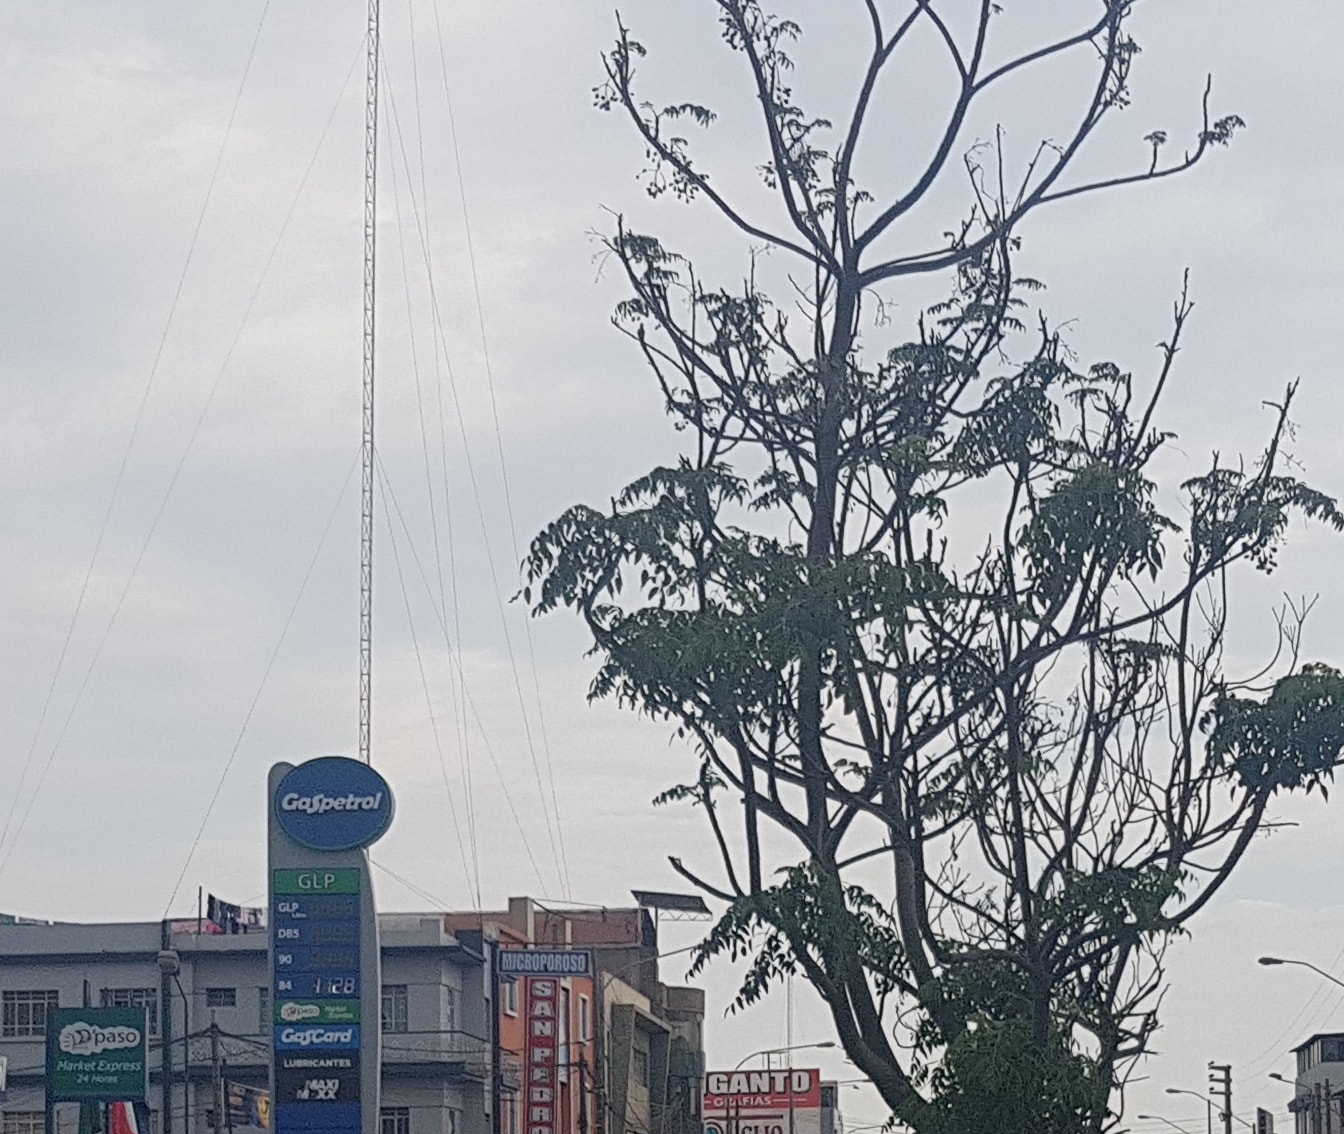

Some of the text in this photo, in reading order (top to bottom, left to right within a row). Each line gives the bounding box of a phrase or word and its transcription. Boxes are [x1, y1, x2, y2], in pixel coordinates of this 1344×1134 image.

[297, 873, 336, 889] GLP
[278, 902, 300, 913] GLP
[278, 928, 300, 939] DB5
[278, 954, 293, 965] 90
[501, 952, 587, 972] MICROPOROSO
[278, 980, 293, 991] 84
[57, 1060, 143, 1072] Market Express
[284, 1059, 352, 1068] LUBRICANTES
[706, 1071, 811, 1095] GANTO
